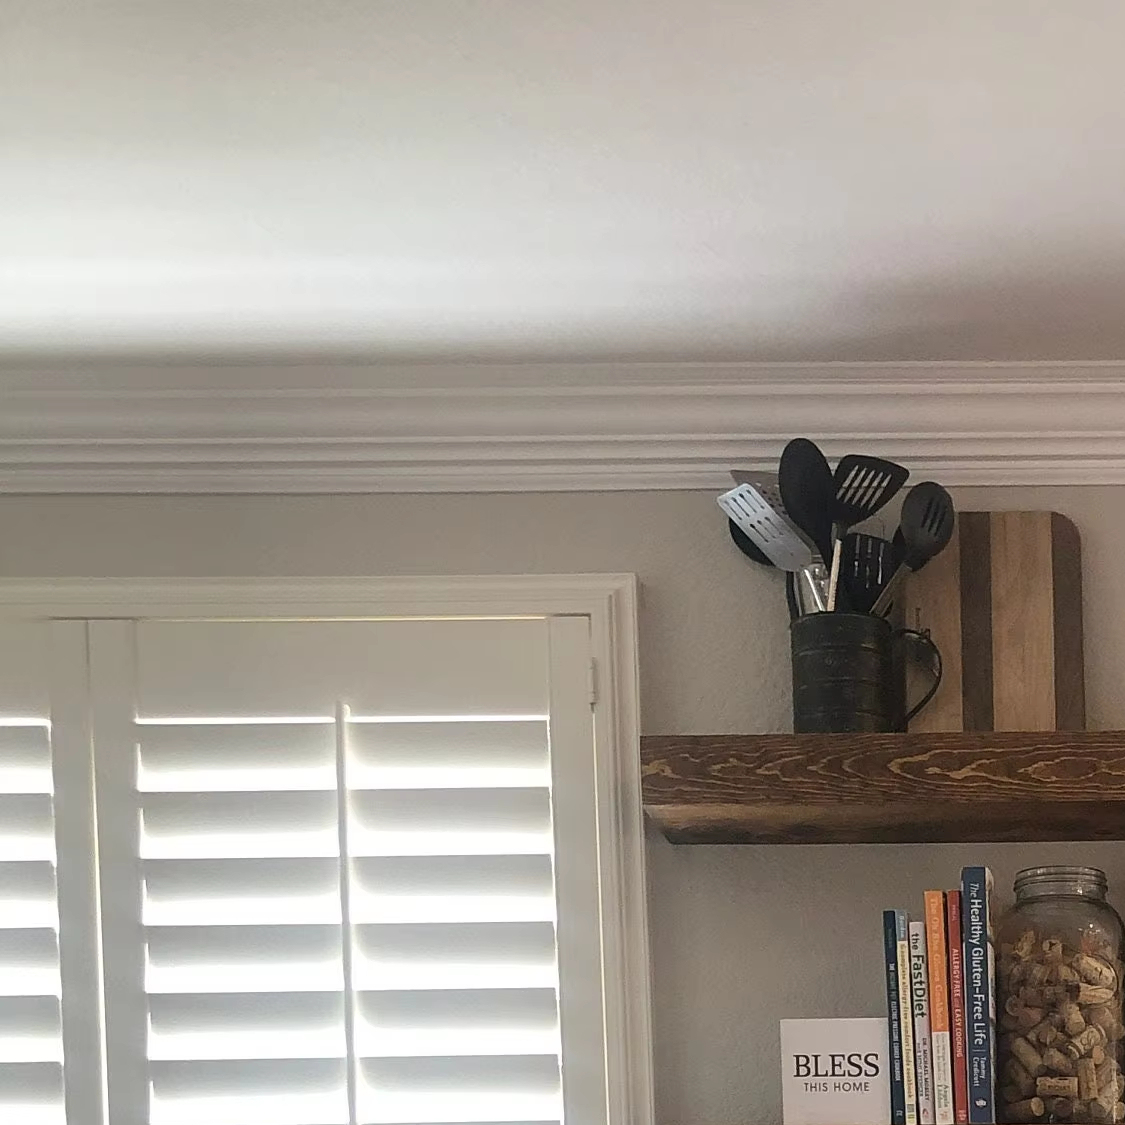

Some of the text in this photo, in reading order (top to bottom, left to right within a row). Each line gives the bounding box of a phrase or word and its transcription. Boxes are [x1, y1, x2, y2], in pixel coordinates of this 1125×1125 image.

[969, 883, 987, 1045] The Healthy Gluten-Free Life
[912, 954, 927, 1018] FastDiet
[954, 1009, 962, 1026] EASY
[955, 1027, 963, 1058] COOKING
[793, 1053, 880, 1077] BLESS
[979, 1057, 987, 1080] Tammy
[804, 1082, 870, 1092] THIS HOME
